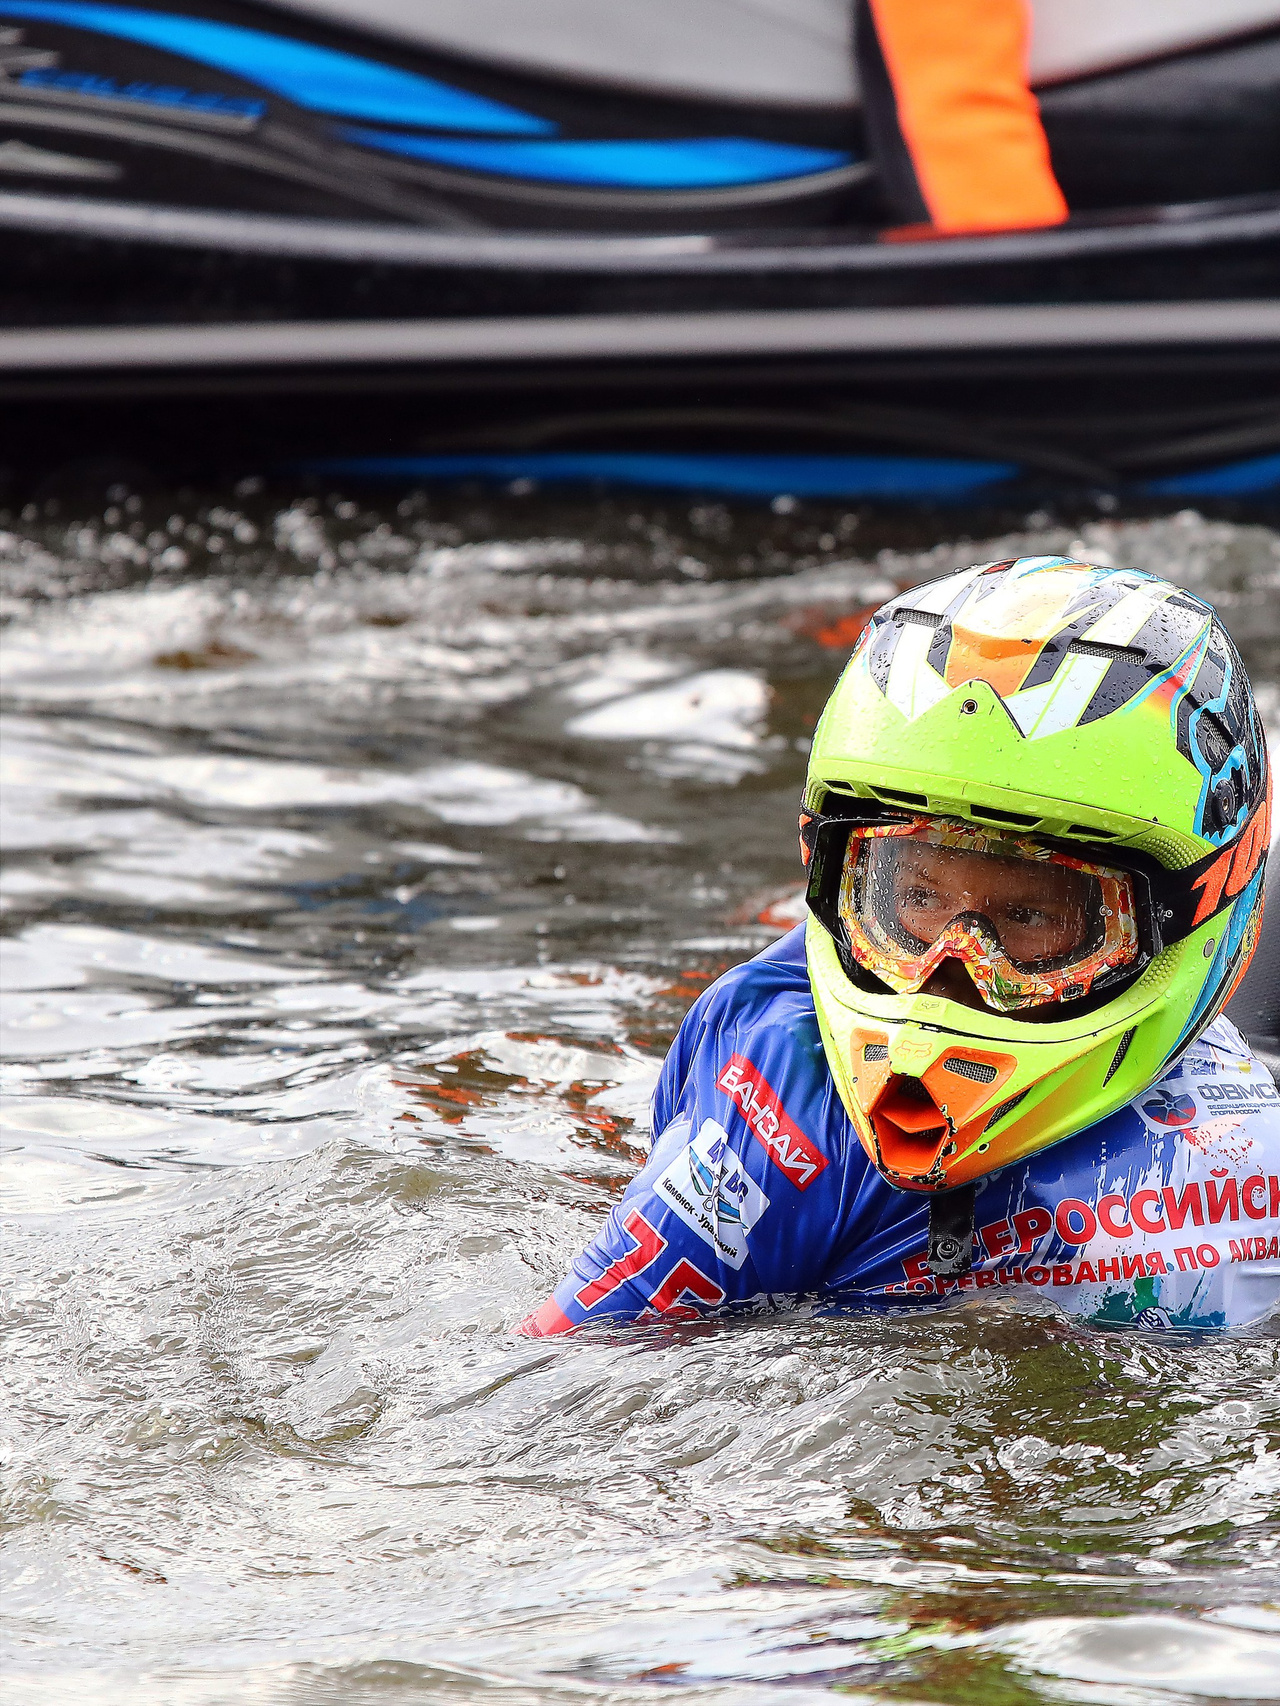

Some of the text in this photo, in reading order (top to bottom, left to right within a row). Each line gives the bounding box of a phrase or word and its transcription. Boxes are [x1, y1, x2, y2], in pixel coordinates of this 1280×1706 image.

[720, 1065, 817, 1184] БАНЗАЙ
[661, 1178, 695, 1215] Каменск
[1173, 1243, 1221, 1272] ПО
